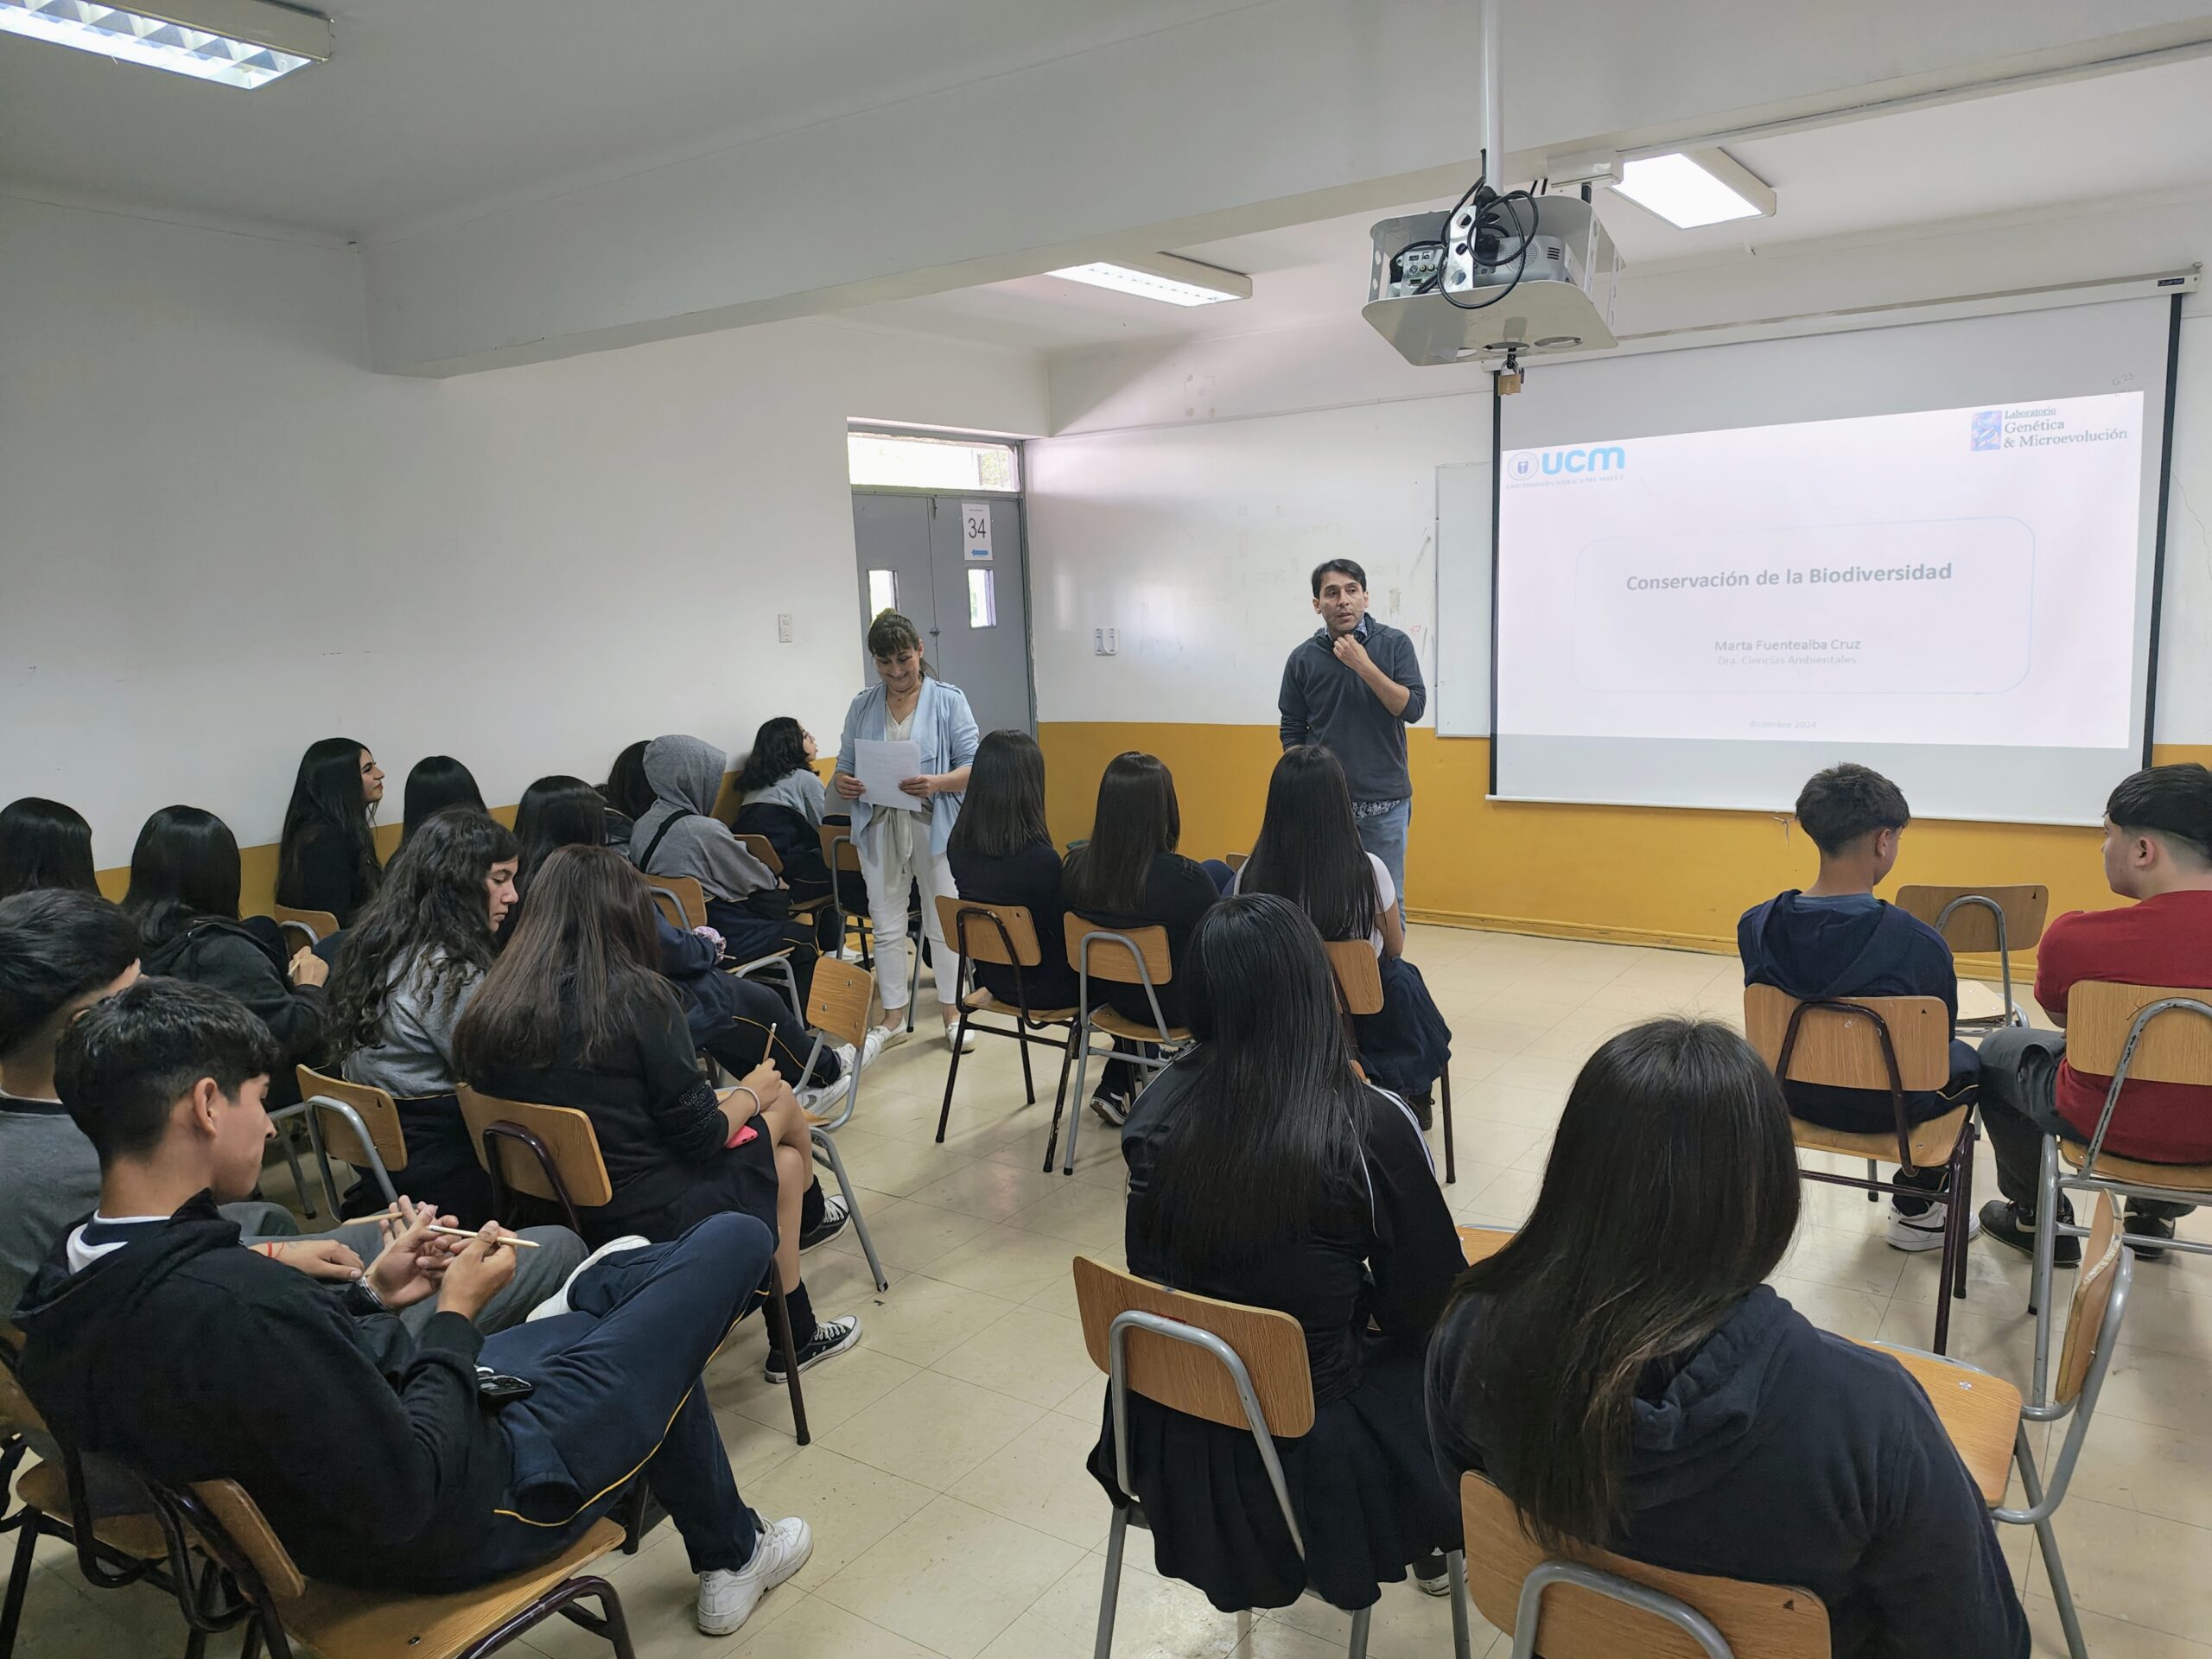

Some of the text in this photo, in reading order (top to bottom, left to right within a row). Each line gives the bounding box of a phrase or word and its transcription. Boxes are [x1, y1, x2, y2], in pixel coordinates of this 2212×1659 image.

[2004, 406, 2057, 419] Laboratorio
[2004, 419, 2065, 434] Genética
[2003, 429, 2128, 448] & Microevolución
[1541, 446, 1626, 475] ucm
[968, 518, 987, 539] 34
[1626, 563, 1953, 591] Conservación de la Biodiversidad
[1714, 639, 1861, 652] Marta Fuentealba Cruz
[1741, 655, 1785, 665] Ciencias
[1787, 654, 1858, 665] Ambientales
